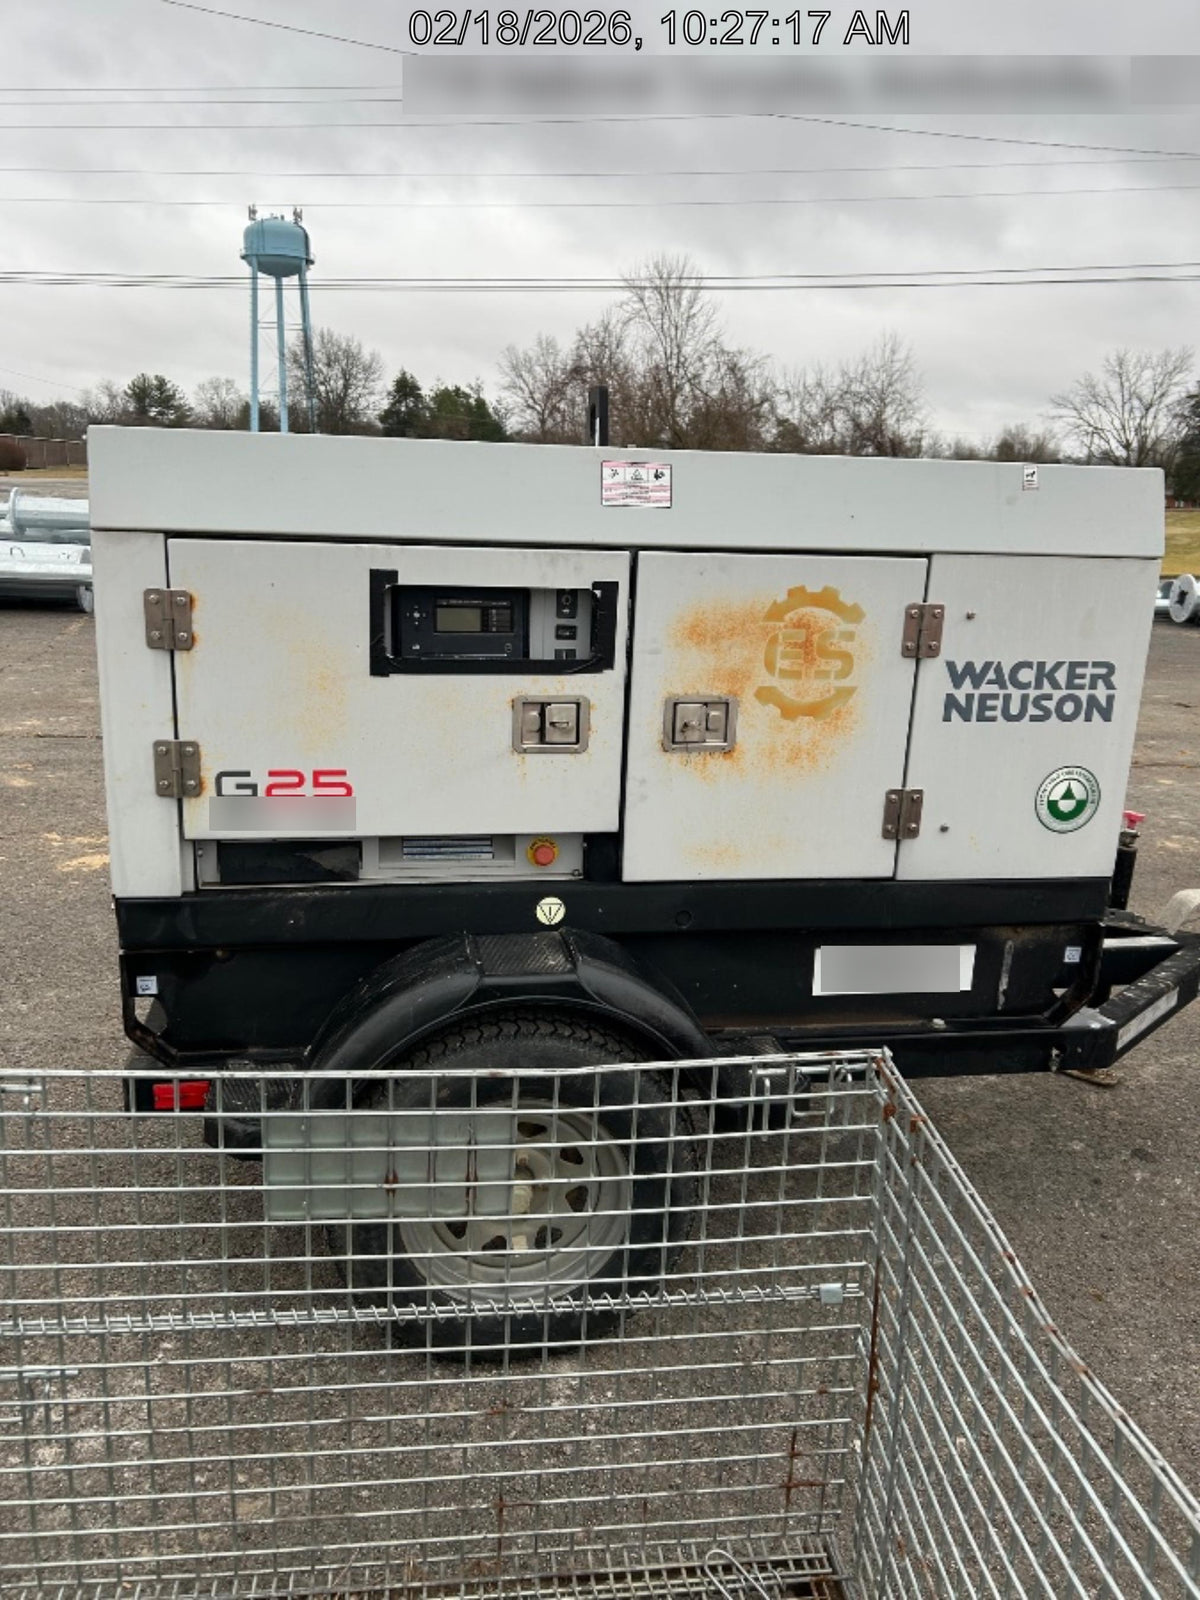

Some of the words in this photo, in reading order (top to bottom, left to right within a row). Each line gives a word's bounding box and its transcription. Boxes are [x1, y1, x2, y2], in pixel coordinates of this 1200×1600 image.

[945, 660, 1117, 690] WACKER
[942, 693, 1116, 722] NEUSON
[215, 769, 354, 797] G25
